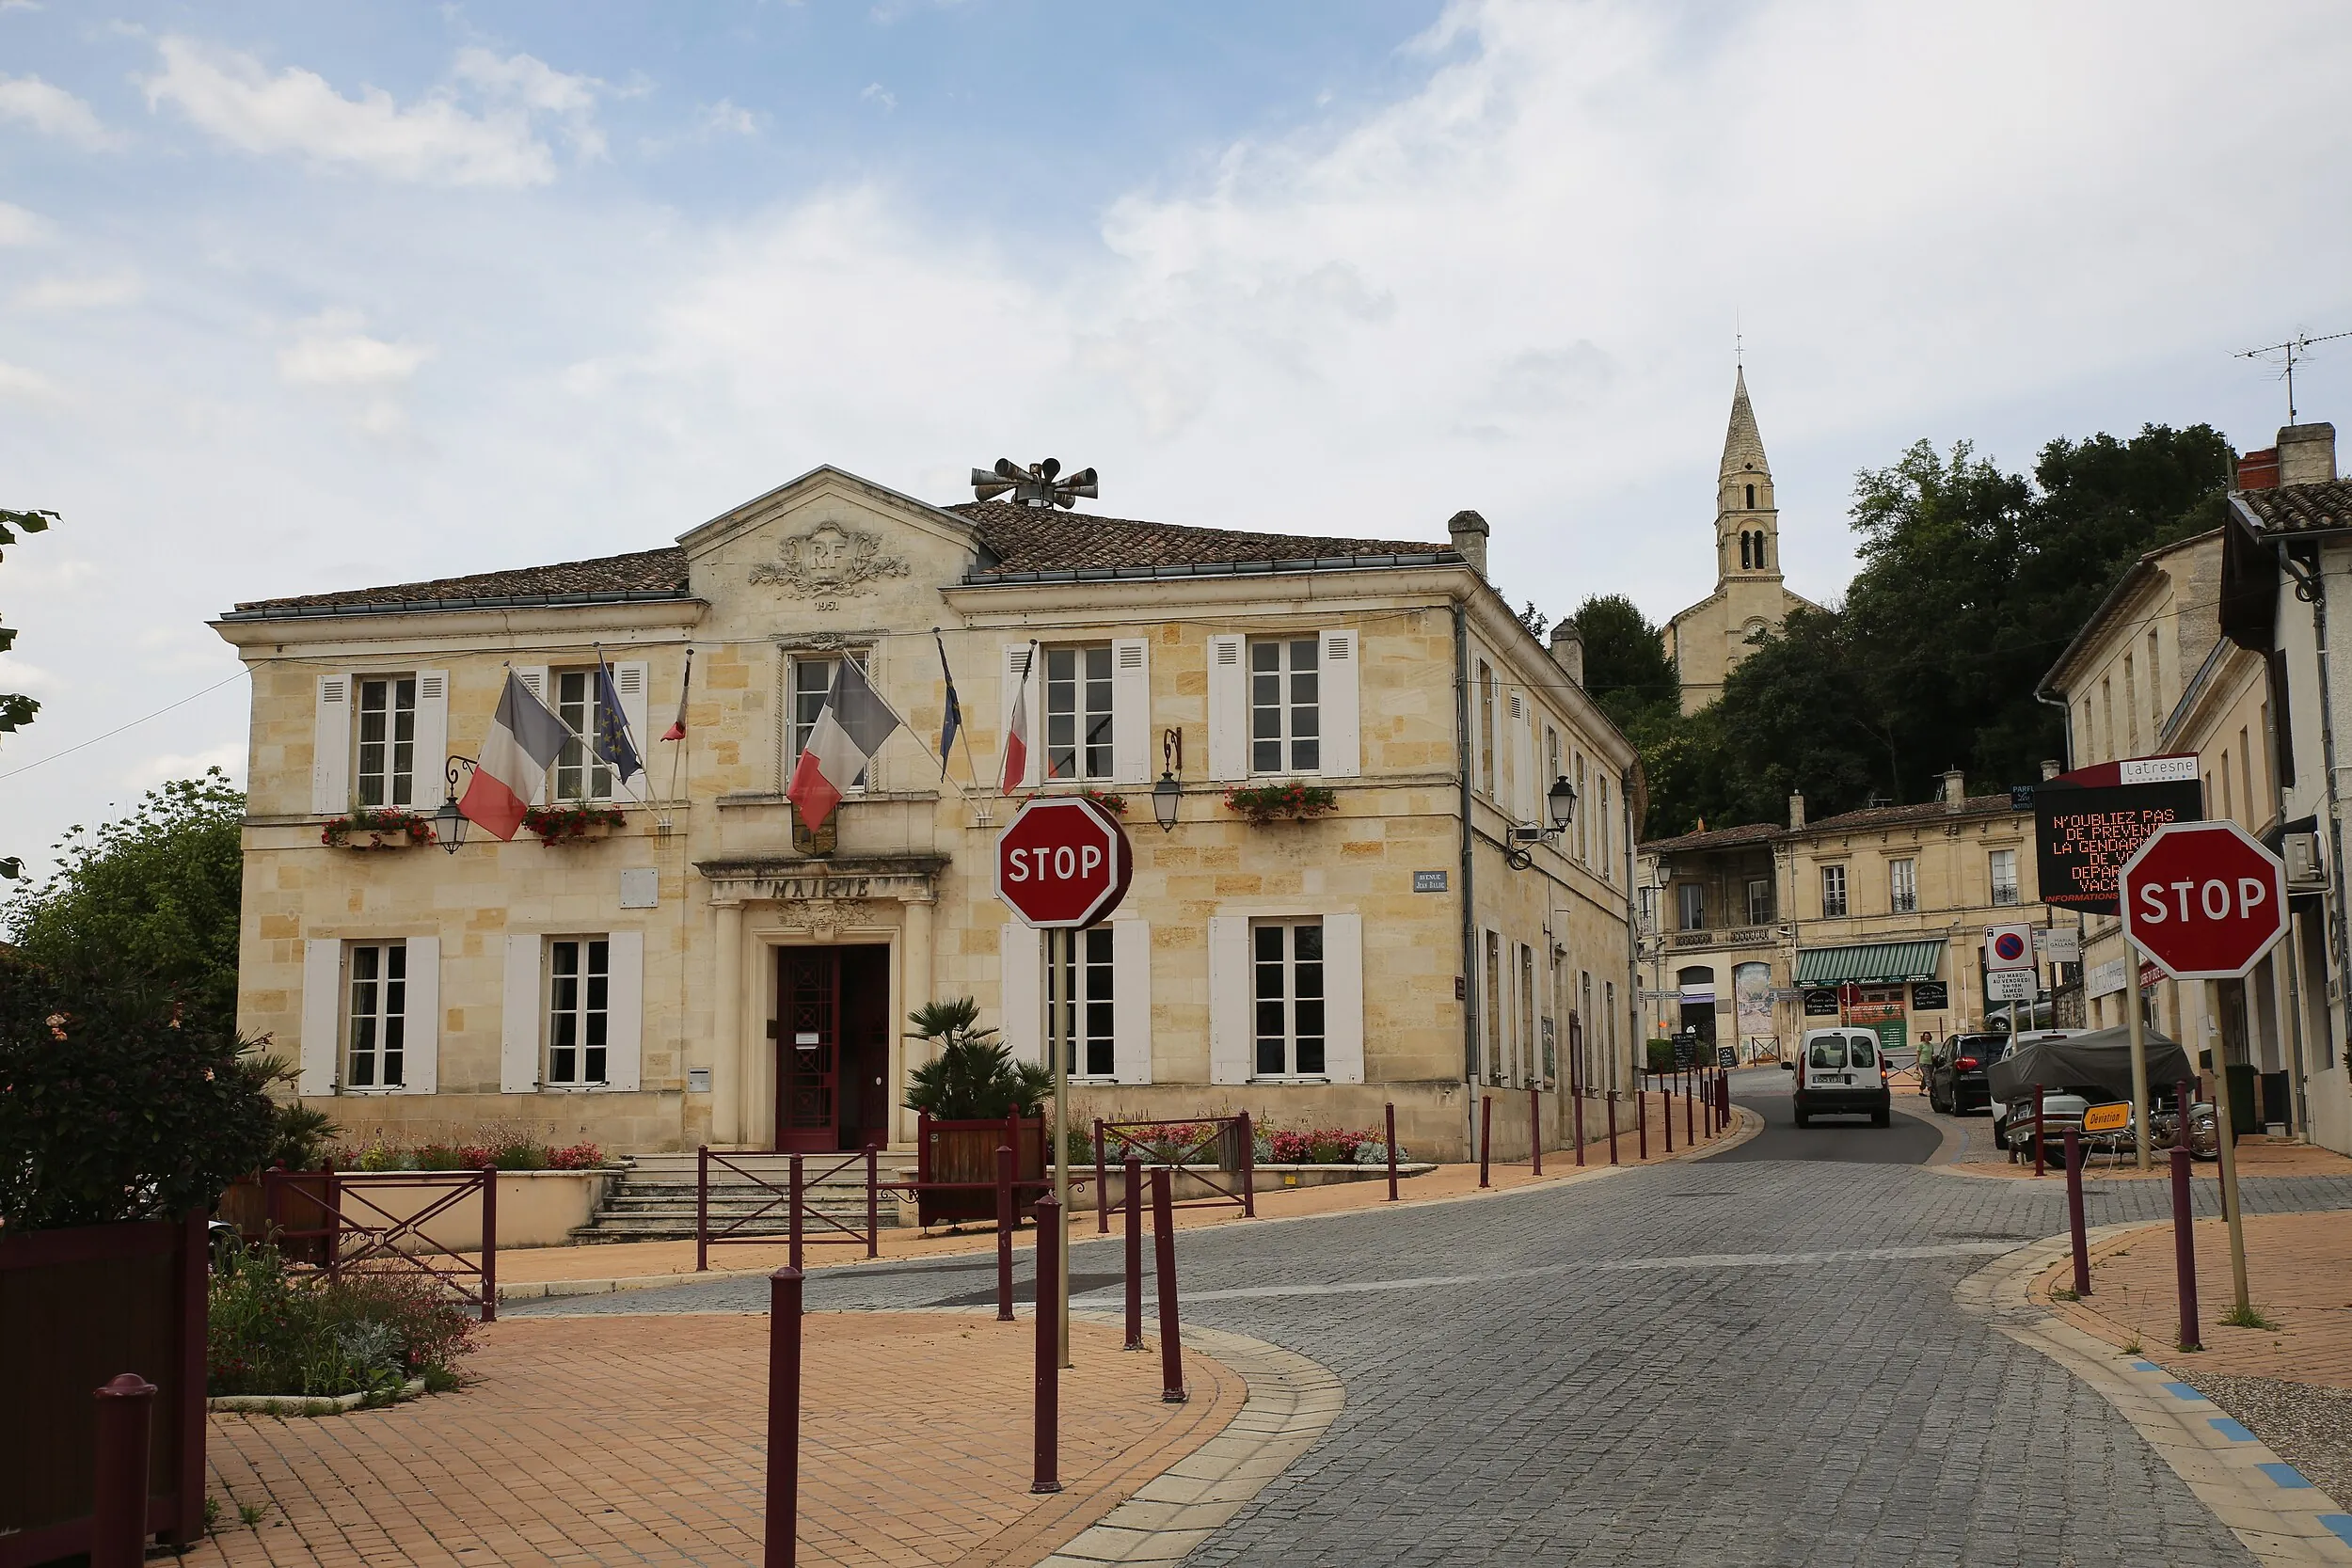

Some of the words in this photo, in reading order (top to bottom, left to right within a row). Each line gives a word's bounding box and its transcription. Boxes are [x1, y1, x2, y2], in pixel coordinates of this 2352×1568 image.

[809, 541, 847, 569] RF
[2054, 812, 2136, 829] N'OUBLIEZ
[2143, 809, 2174, 823] PAS
[2066, 828, 2085, 841] DE
[2092, 822, 2165, 839] PREVENI
[2053, 841, 2073, 855] LA
[1009, 845, 1102, 882] STOP
[2090, 852, 2108, 865] DE
[2072, 864, 2124, 879] DEPAR
[771, 877, 870, 898] MAIRIE
[2044, 893, 2120, 903] INFORMATIONS
[2140, 878, 2266, 924] STOP
[2090, 1112, 2121, 1125] Déviation
